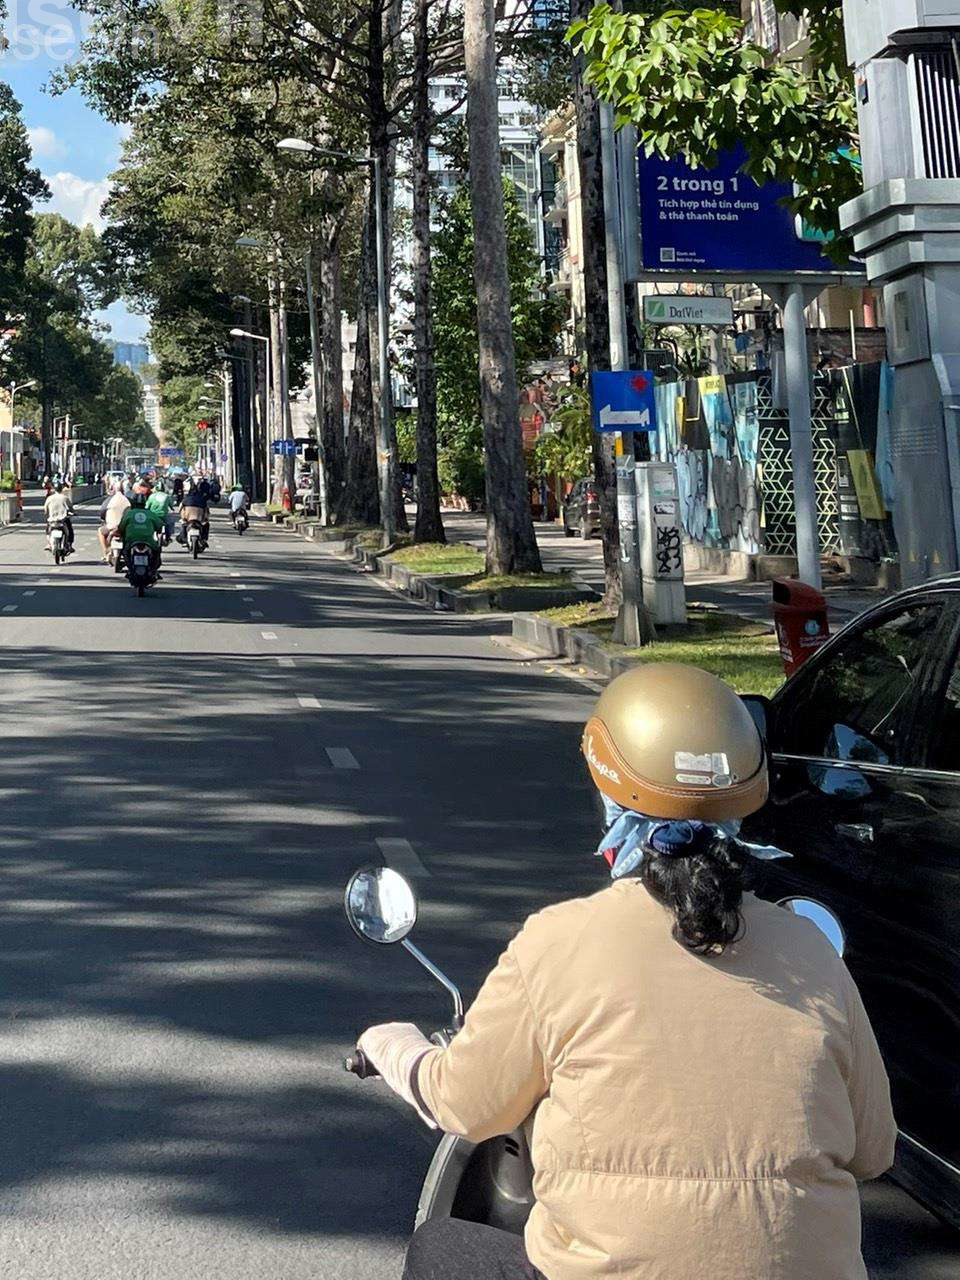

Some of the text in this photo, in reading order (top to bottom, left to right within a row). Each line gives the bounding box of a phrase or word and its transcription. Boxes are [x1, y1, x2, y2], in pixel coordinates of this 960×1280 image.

[657, 175, 739, 195] 2 trong 1
[734, 200, 759, 211] dụng
[659, 211, 667, 220] &
[686, 211, 715, 220] thanh
[716, 211, 739, 221] toán
